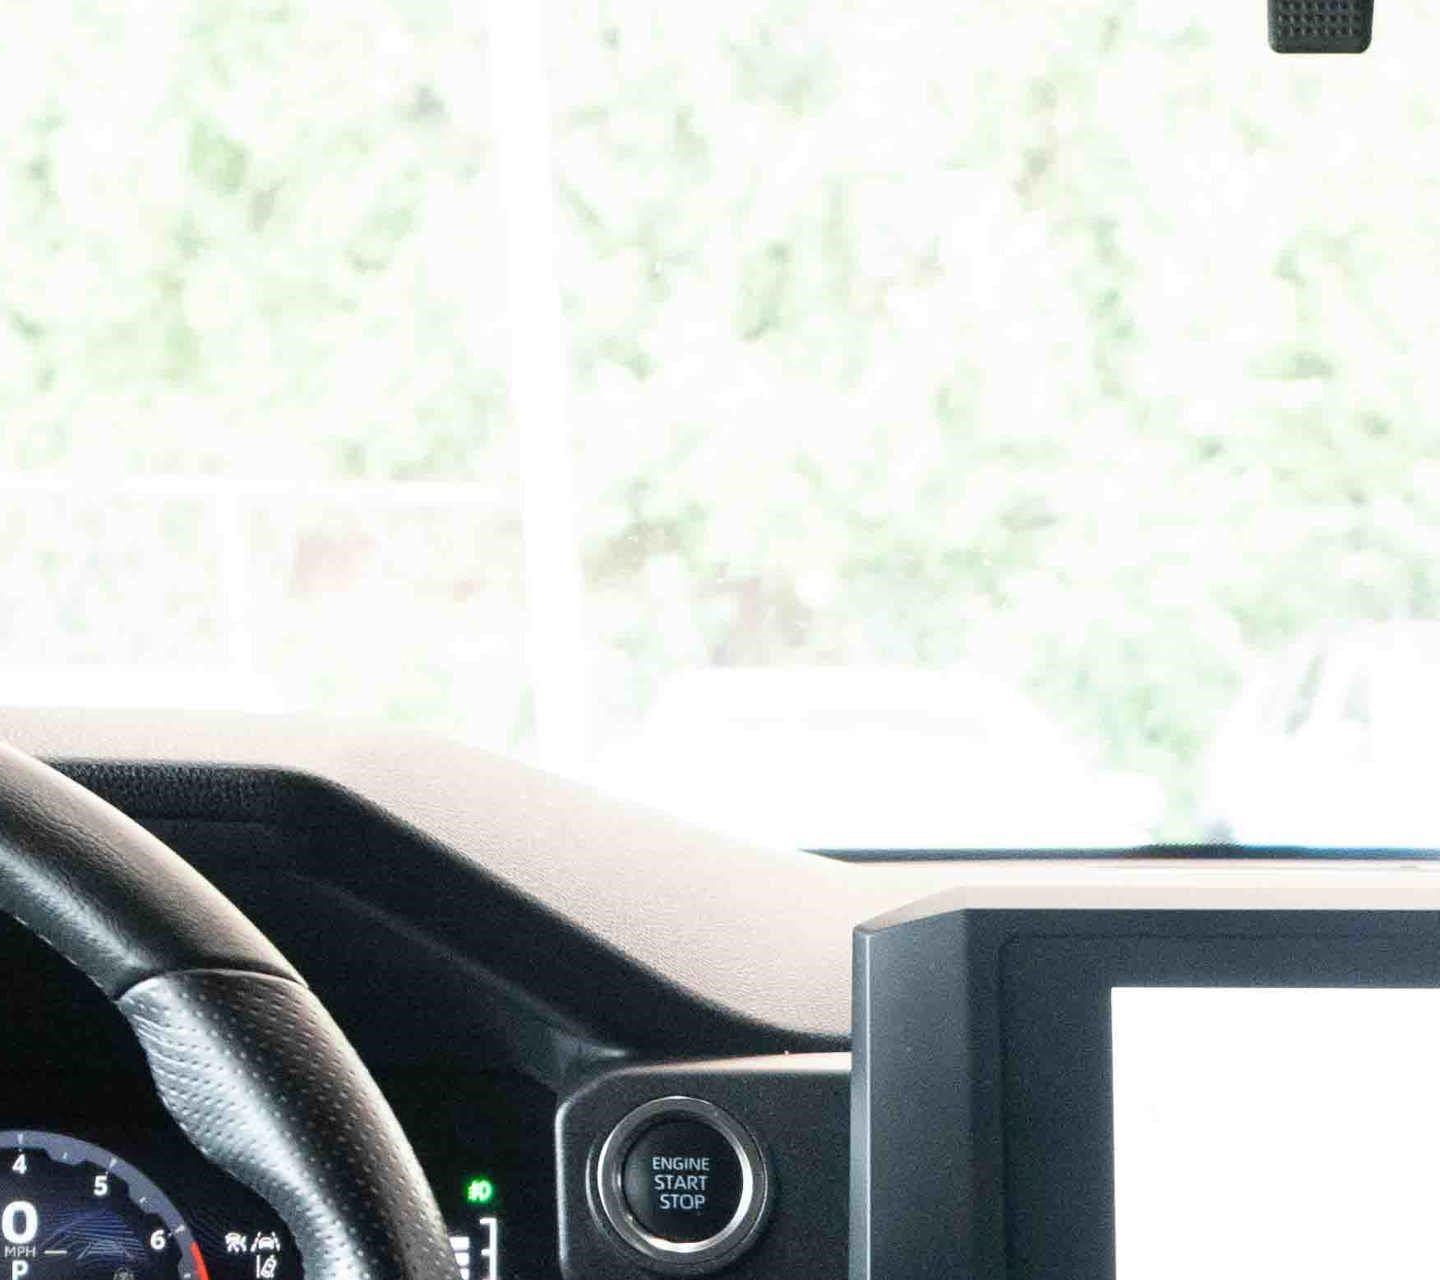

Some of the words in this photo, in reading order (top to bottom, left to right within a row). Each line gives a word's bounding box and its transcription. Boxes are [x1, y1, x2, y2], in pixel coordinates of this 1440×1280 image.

[12, 1154, 27, 1174] 4
[652, 1157, 710, 1171] ENGINE
[93, 1176, 108, 1196] 5
[654, 1174, 708, 1190] START
[660, 1194, 705, 1209] STOP
[1, 1200, 39, 1244] 0
[150, 1230, 166, 1249] 6
[4, 1246, 36, 1257] MPH
